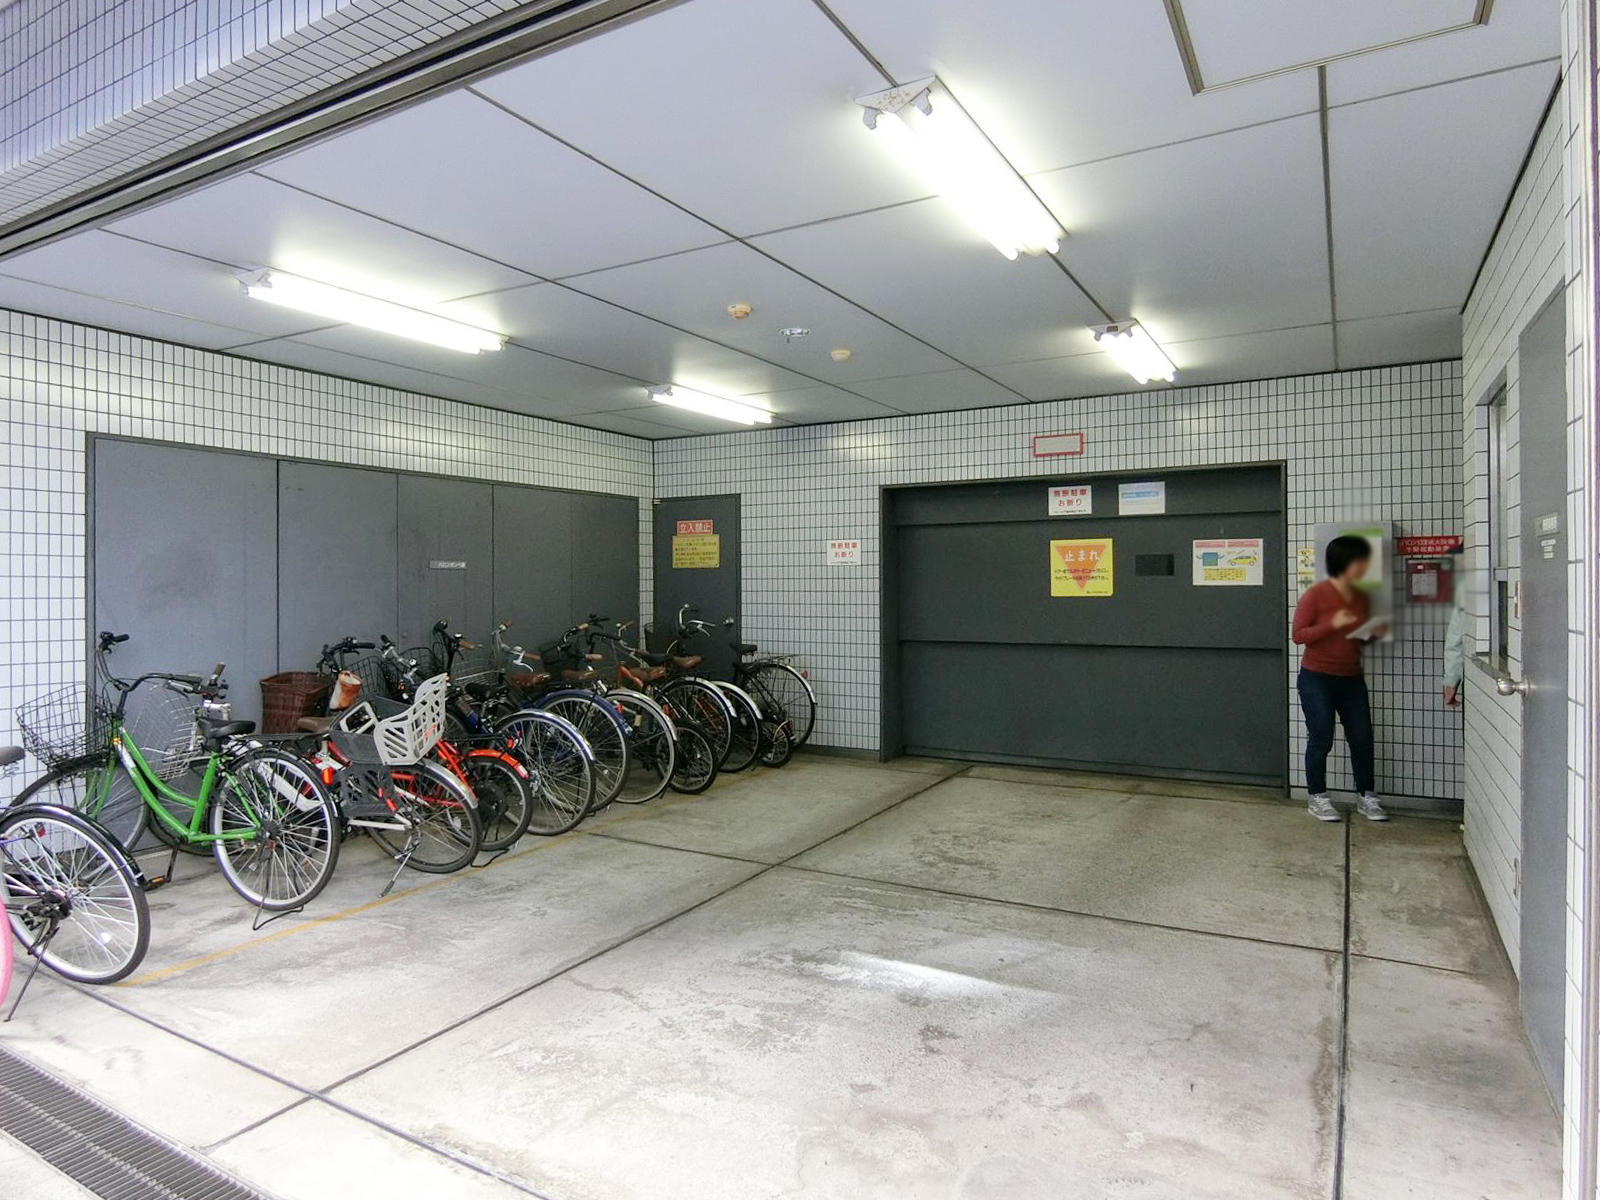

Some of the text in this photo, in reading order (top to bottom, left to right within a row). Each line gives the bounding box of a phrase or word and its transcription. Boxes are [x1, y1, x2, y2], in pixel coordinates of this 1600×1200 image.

[1058, 498, 1082, 507] お断り
[680, 522, 712, 533] 立入禁止
[1064, 550, 1099, 562] 止まれ
